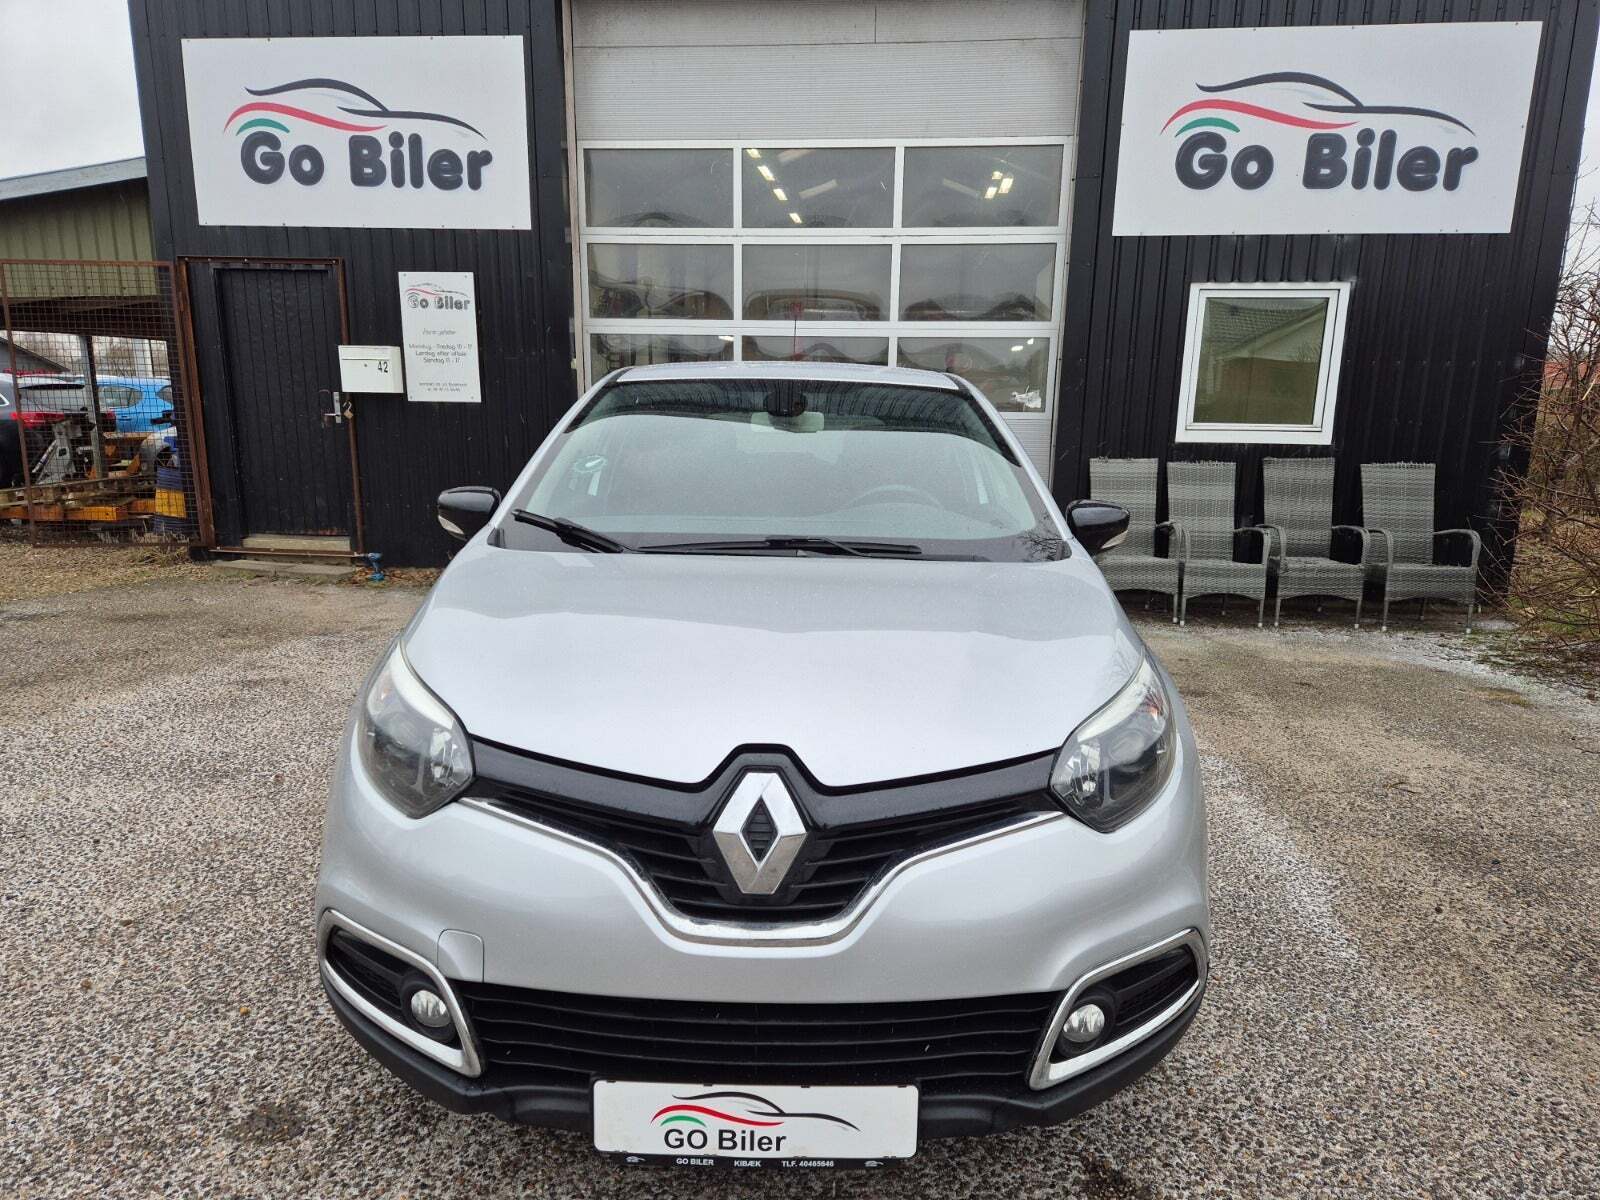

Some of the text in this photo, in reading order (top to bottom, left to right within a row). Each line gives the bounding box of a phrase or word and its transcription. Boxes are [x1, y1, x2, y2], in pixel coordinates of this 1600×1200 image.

[240, 130, 493, 191] Go Biler
[1174, 127, 1480, 192] Go Biler
[434, 295, 470, 310] Biler
[378, 361, 389, 373] 42
[663, 1128, 787, 1152] GO Biler
[676, 1157, 689, 1165] GO
[690, 1158, 714, 1166] BILER
[734, 1160, 762, 1168] KIBÆK
